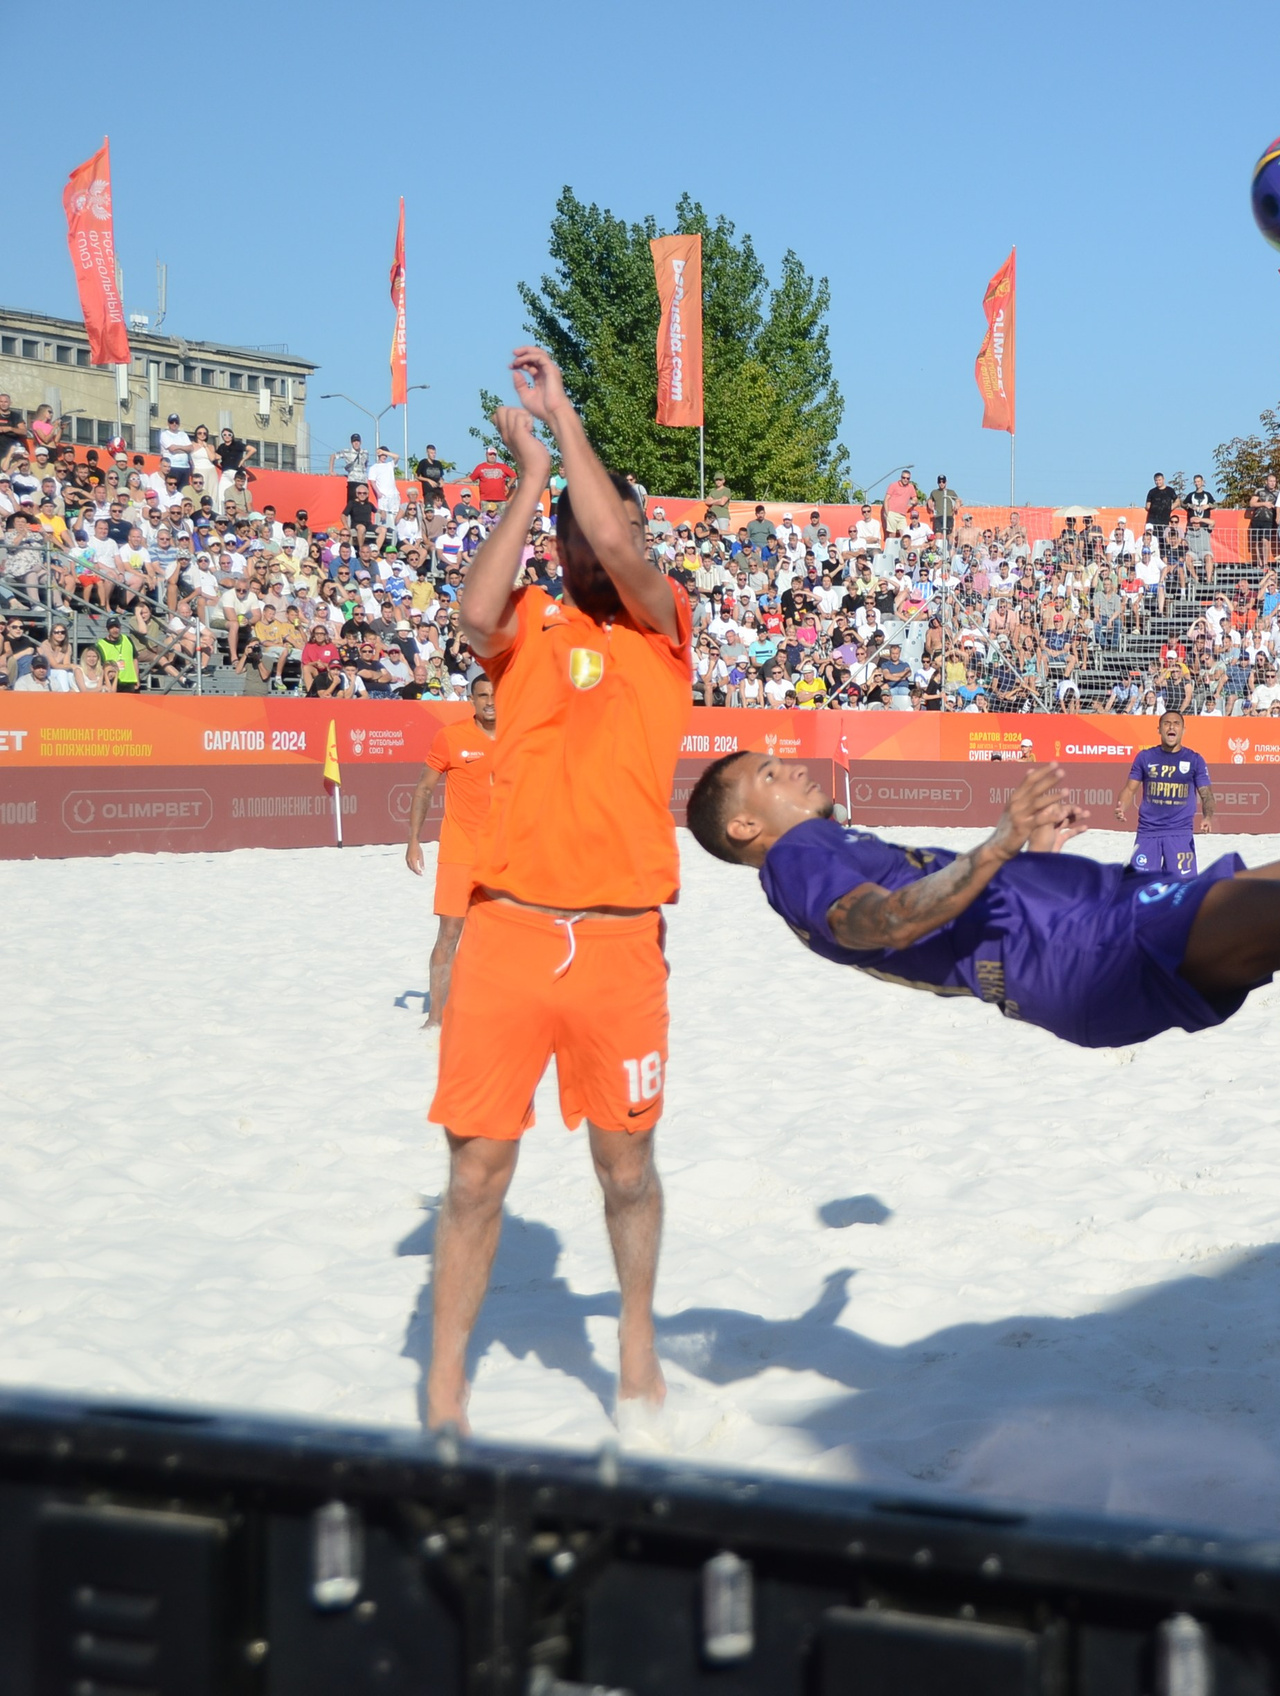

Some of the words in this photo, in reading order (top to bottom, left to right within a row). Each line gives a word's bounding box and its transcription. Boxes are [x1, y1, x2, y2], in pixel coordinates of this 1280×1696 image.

[89, 230, 122, 323] ФУТБОЛЬНЫЙ
[40, 728, 94, 741] ЧЕМПИОНАТ
[97, 728, 133, 741] РОССИИ
[203, 730, 265, 750] САРАТОВ
[271, 731, 306, 750] 2024
[368, 738, 404, 746] ФУТБОЛЬНЫЙ
[779, 738, 801, 746] ПЛЯЖНЫЙ
[969, 732, 1000, 741] САРАТОВ
[1003, 732, 1022, 741] 2024
[40, 744, 53, 757] ПО
[55, 744, 110, 757] ПЛЯЖНОМУ
[112, 744, 153, 757] ФУТБОЛУ
[680, 735, 710, 752] РАТОВ
[714, 736, 738, 752] 2024
[1065, 745, 1133, 755] OLIMPBET
[877, 787, 964, 801] OLIMPBET
[989, 788, 1001, 804] ЗА
[1084, 789, 1113, 805] 1000
[1212, 792, 1260, 805] PBET
[102, 802, 202, 819] OLIMPBET
[232, 799, 245, 817] ЗА
[248, 796, 312, 817] ПОПОЛНЕНИЕ
[314, 796, 326, 815] ОТ
[622, 1050, 662, 1103] 18
